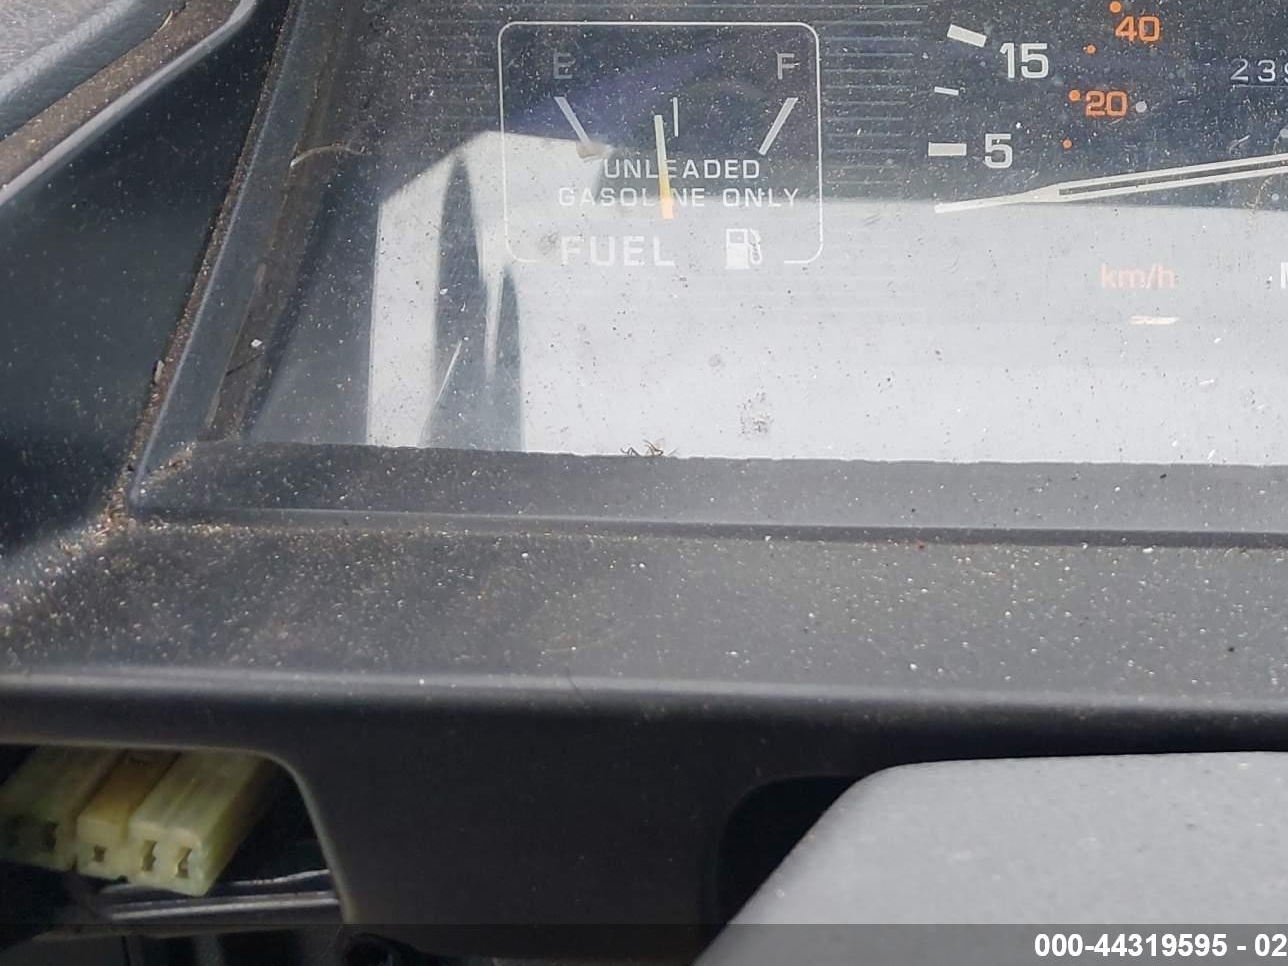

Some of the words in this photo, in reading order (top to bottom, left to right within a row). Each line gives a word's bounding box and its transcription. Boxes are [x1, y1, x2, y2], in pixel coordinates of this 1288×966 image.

[1114, 15, 1160, 42] 40
[553, 52, 574, 80] E
[776, 52, 797, 80] F
[999, 42, 1049, 79] 15
[1084, 90, 1127, 117] 20
[983, 133, 1013, 170] 5
[558, 187, 705, 208] GASOLNE
[722, 187, 799, 208] ONLY
[560, 235, 676, 267] FUEL
[1099, 262, 1176, 290] km/h
